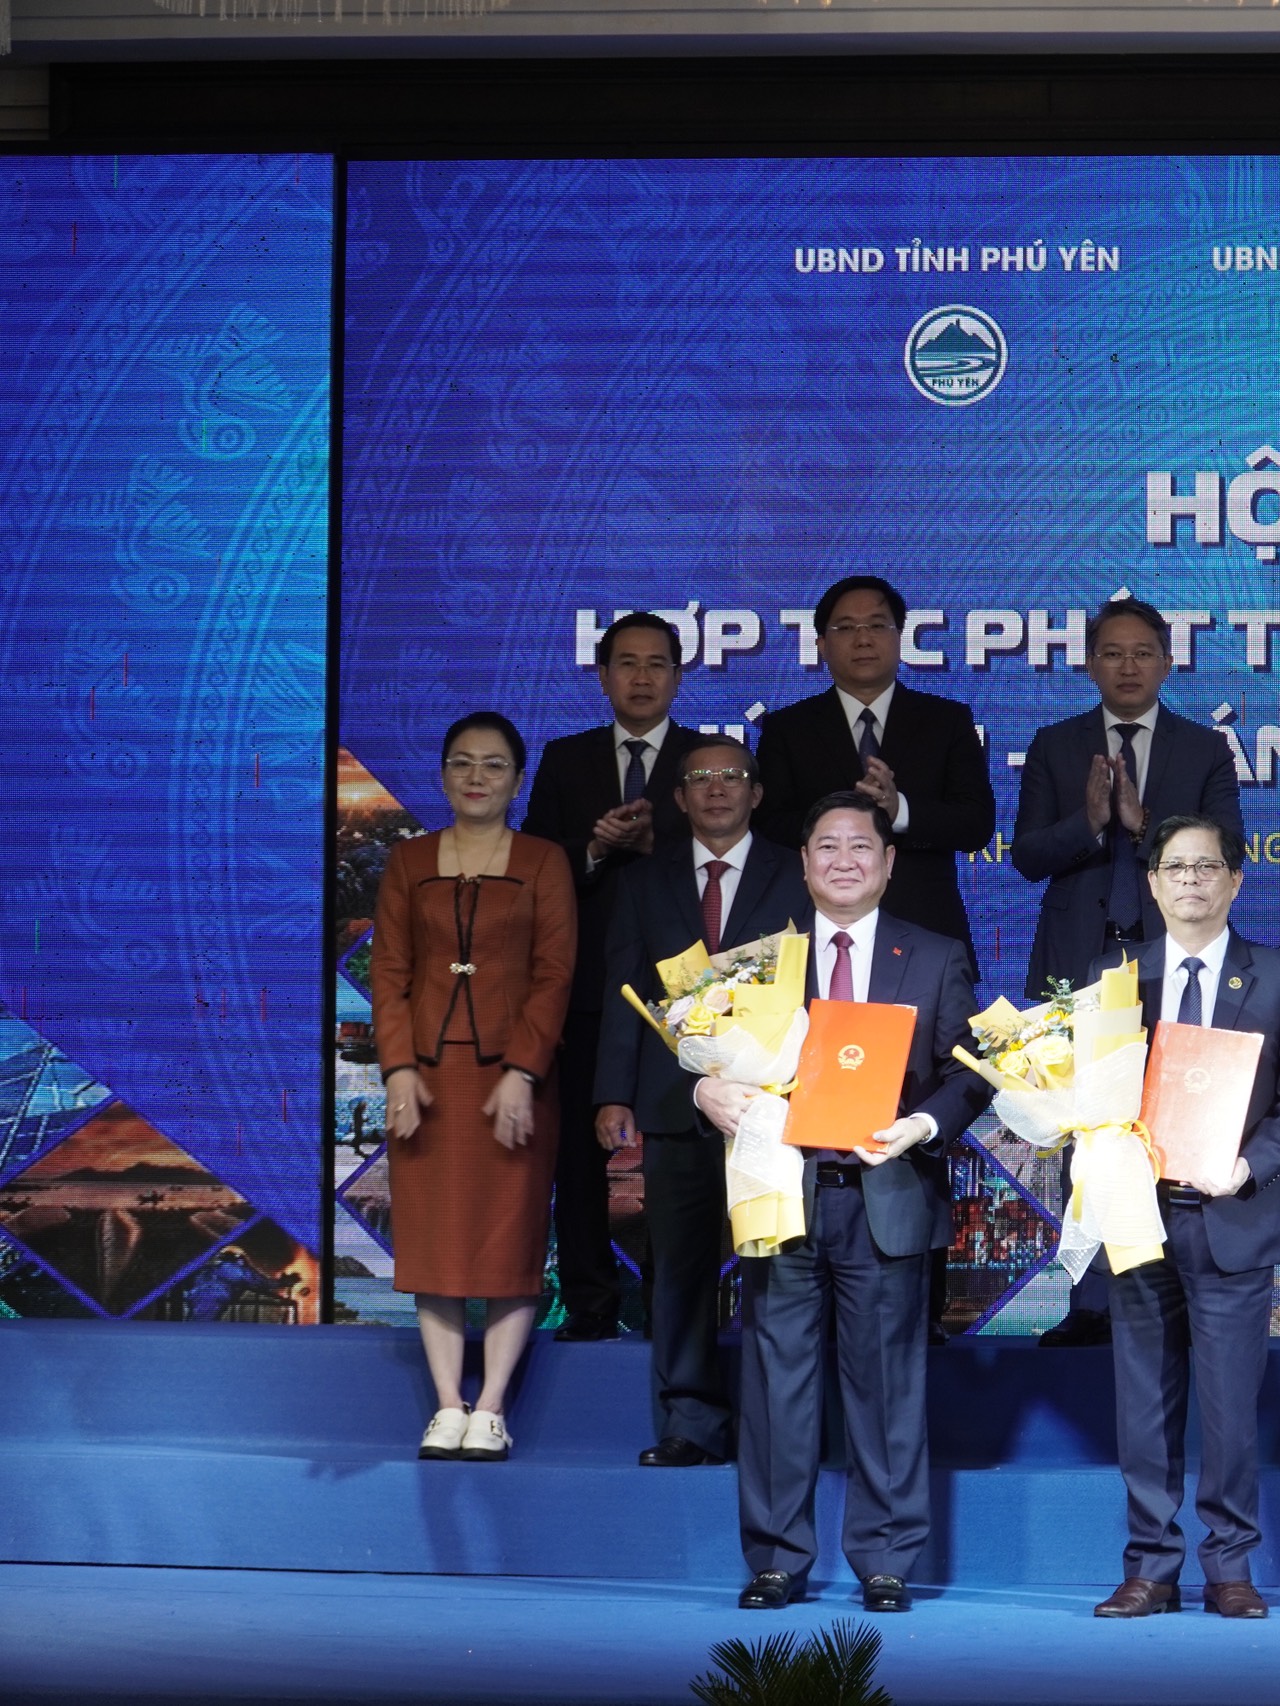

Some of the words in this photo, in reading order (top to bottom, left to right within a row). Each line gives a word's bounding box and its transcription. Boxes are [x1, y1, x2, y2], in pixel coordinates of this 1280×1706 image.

[794, 248, 885, 273] UBND
[895, 238, 969, 272] TỈNH
[980, 239, 1047, 272] PHÚ
[1060, 239, 1121, 272] YÊN
[780, 609, 944, 665] TC
[965, 587, 1211, 665] PHT
